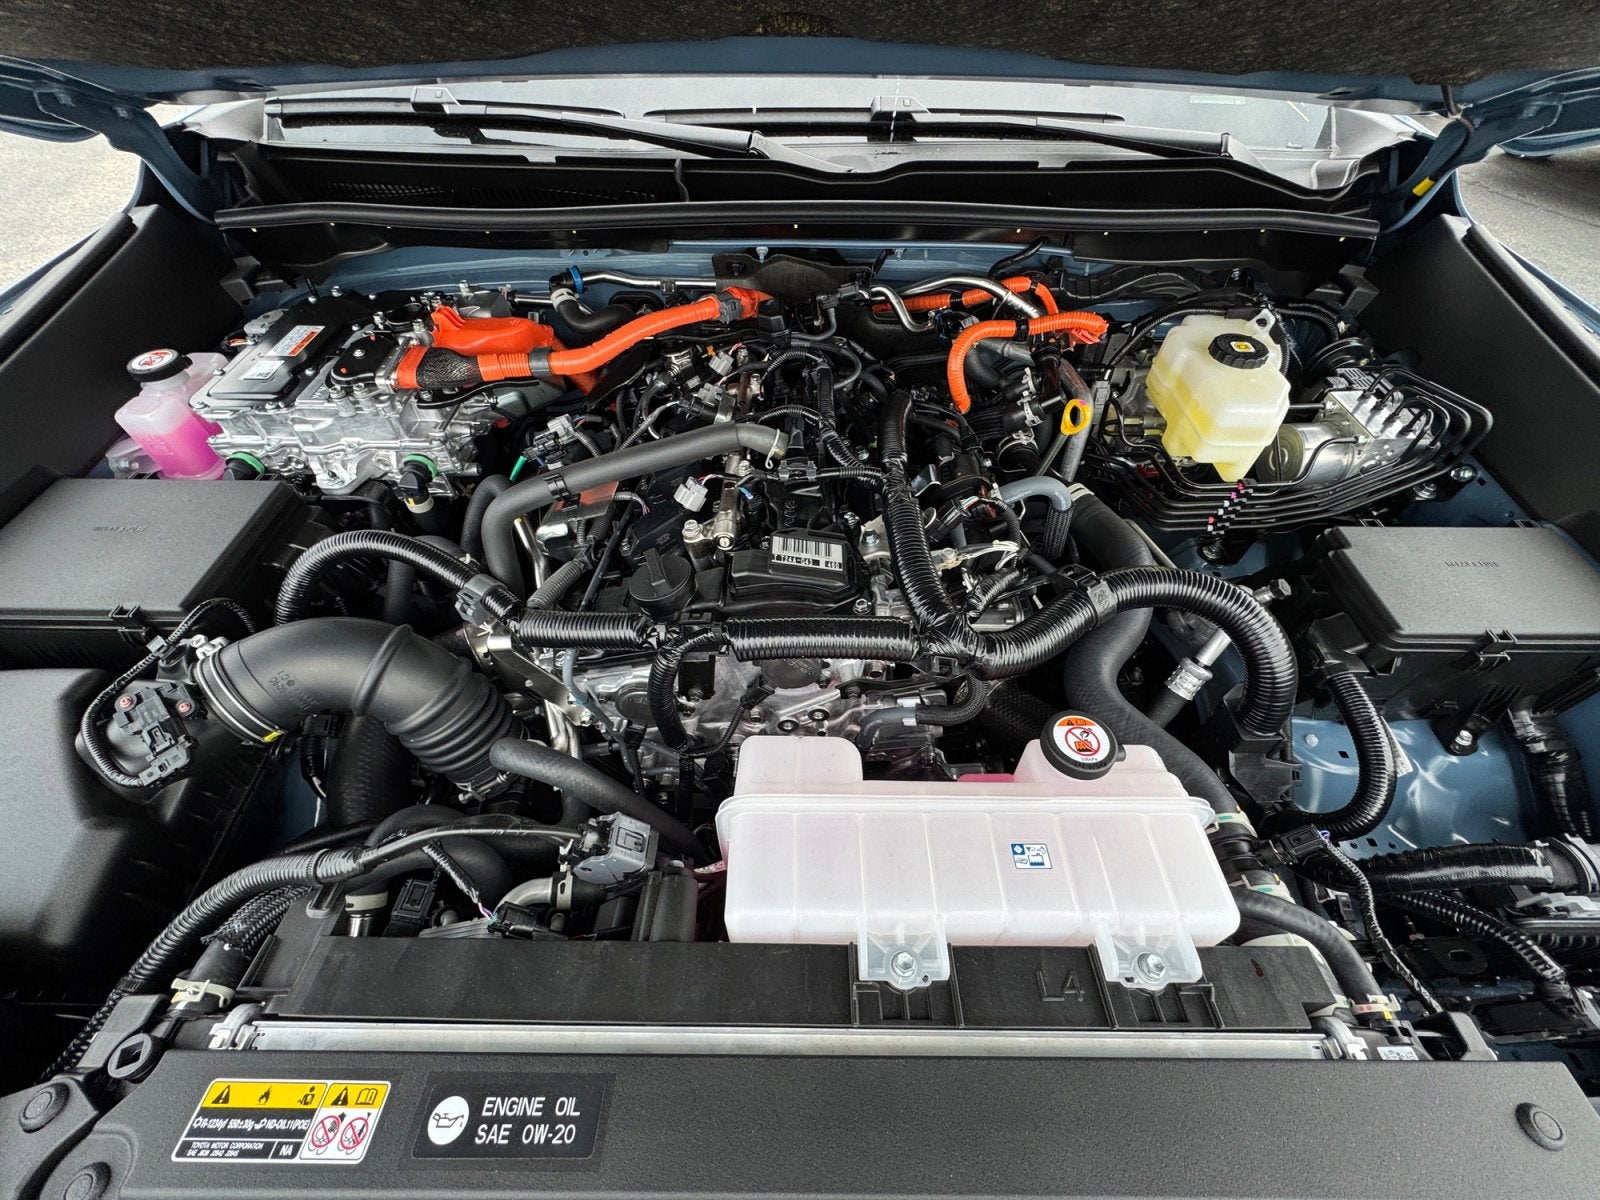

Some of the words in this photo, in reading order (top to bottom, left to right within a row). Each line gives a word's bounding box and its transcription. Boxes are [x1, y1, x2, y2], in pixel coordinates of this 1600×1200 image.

[481, 1097, 545, 1116] ENGINE
[555, 1097, 580, 1116] OIL
[475, 1124, 512, 1144] SAE
[522, 1124, 576, 1144] 0W-20
[191, 1141, 210, 1149] TOYOTA
[211, 1141, 230, 1149] MOTOR
[230, 1142, 264, 1150] CORPORATION
[279, 1144, 293, 1156] NA
